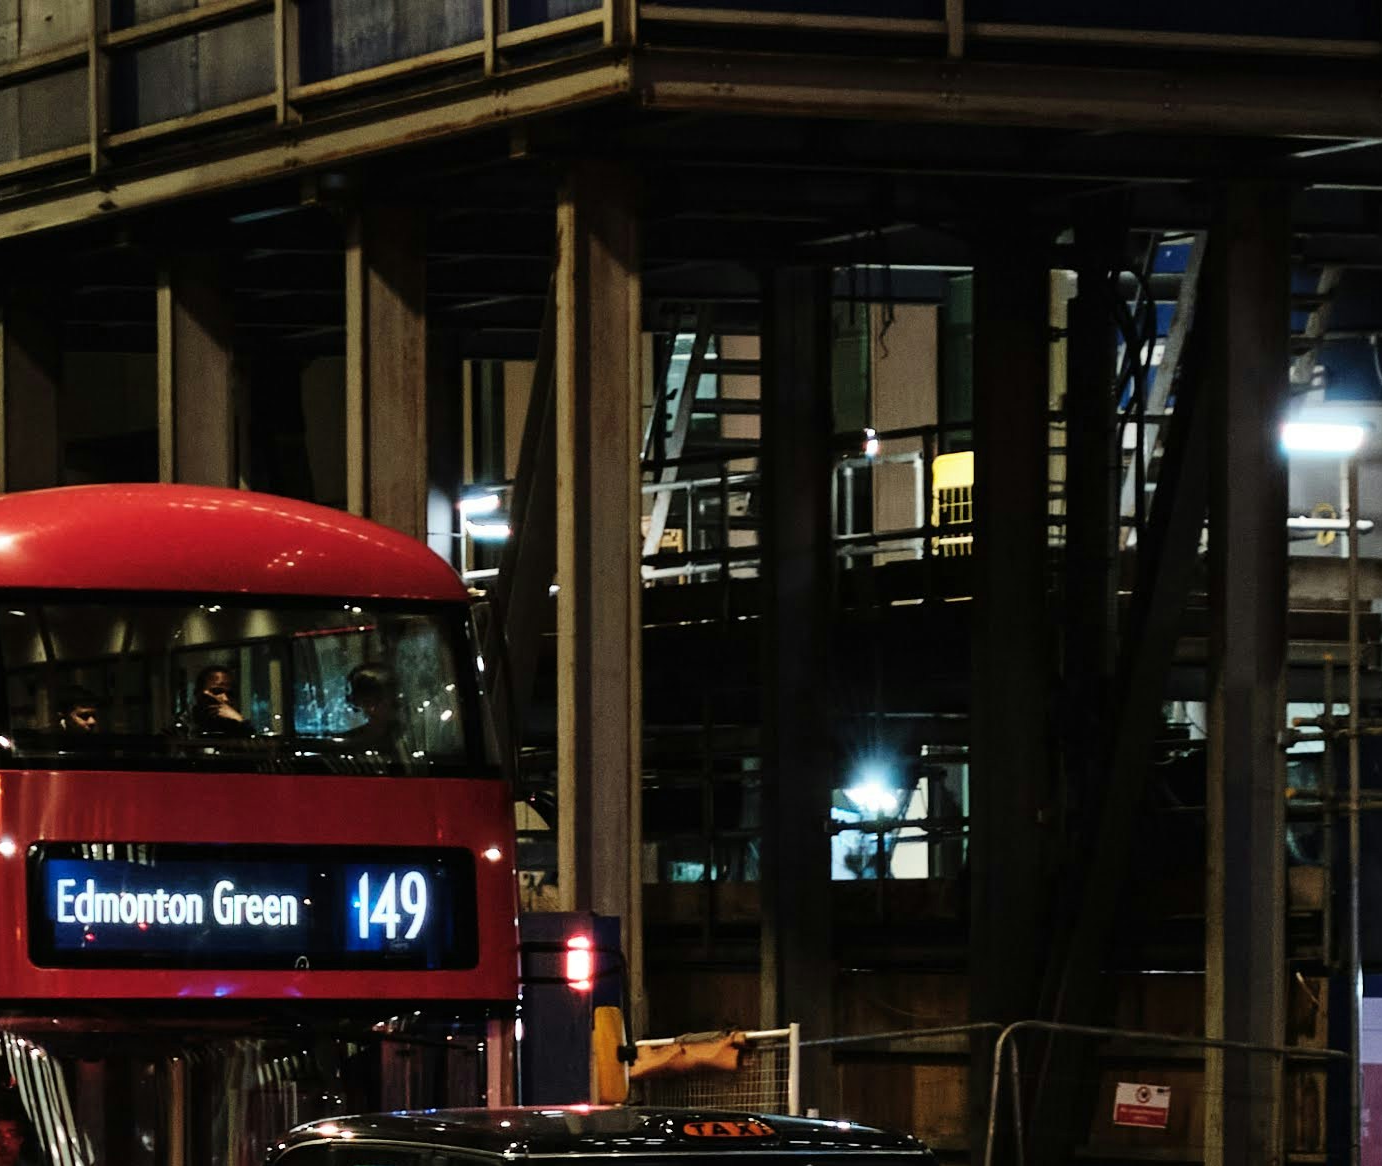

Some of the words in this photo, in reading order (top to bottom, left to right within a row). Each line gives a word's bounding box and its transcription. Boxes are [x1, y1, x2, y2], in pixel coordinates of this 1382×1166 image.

[57, 878, 203, 925] Edmonton
[212, 879, 298, 927] Green
[357, 870, 428, 940] 149
